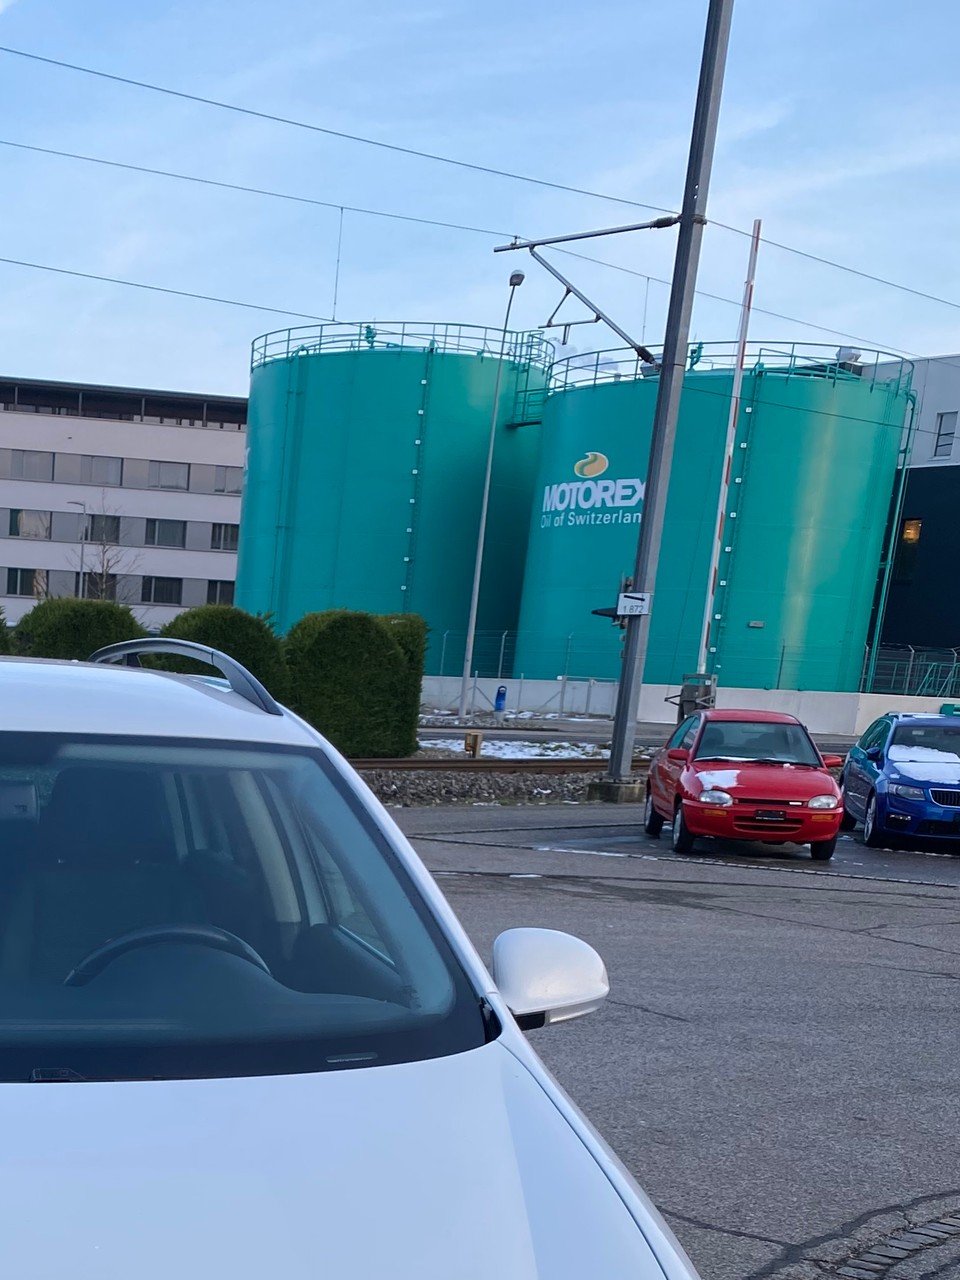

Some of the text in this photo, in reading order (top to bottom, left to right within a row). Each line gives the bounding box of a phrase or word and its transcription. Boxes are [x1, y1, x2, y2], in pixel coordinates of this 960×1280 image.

[543, 478, 645, 512] MOTOREX
[541, 510, 642, 528] Oil of Switzerlan
